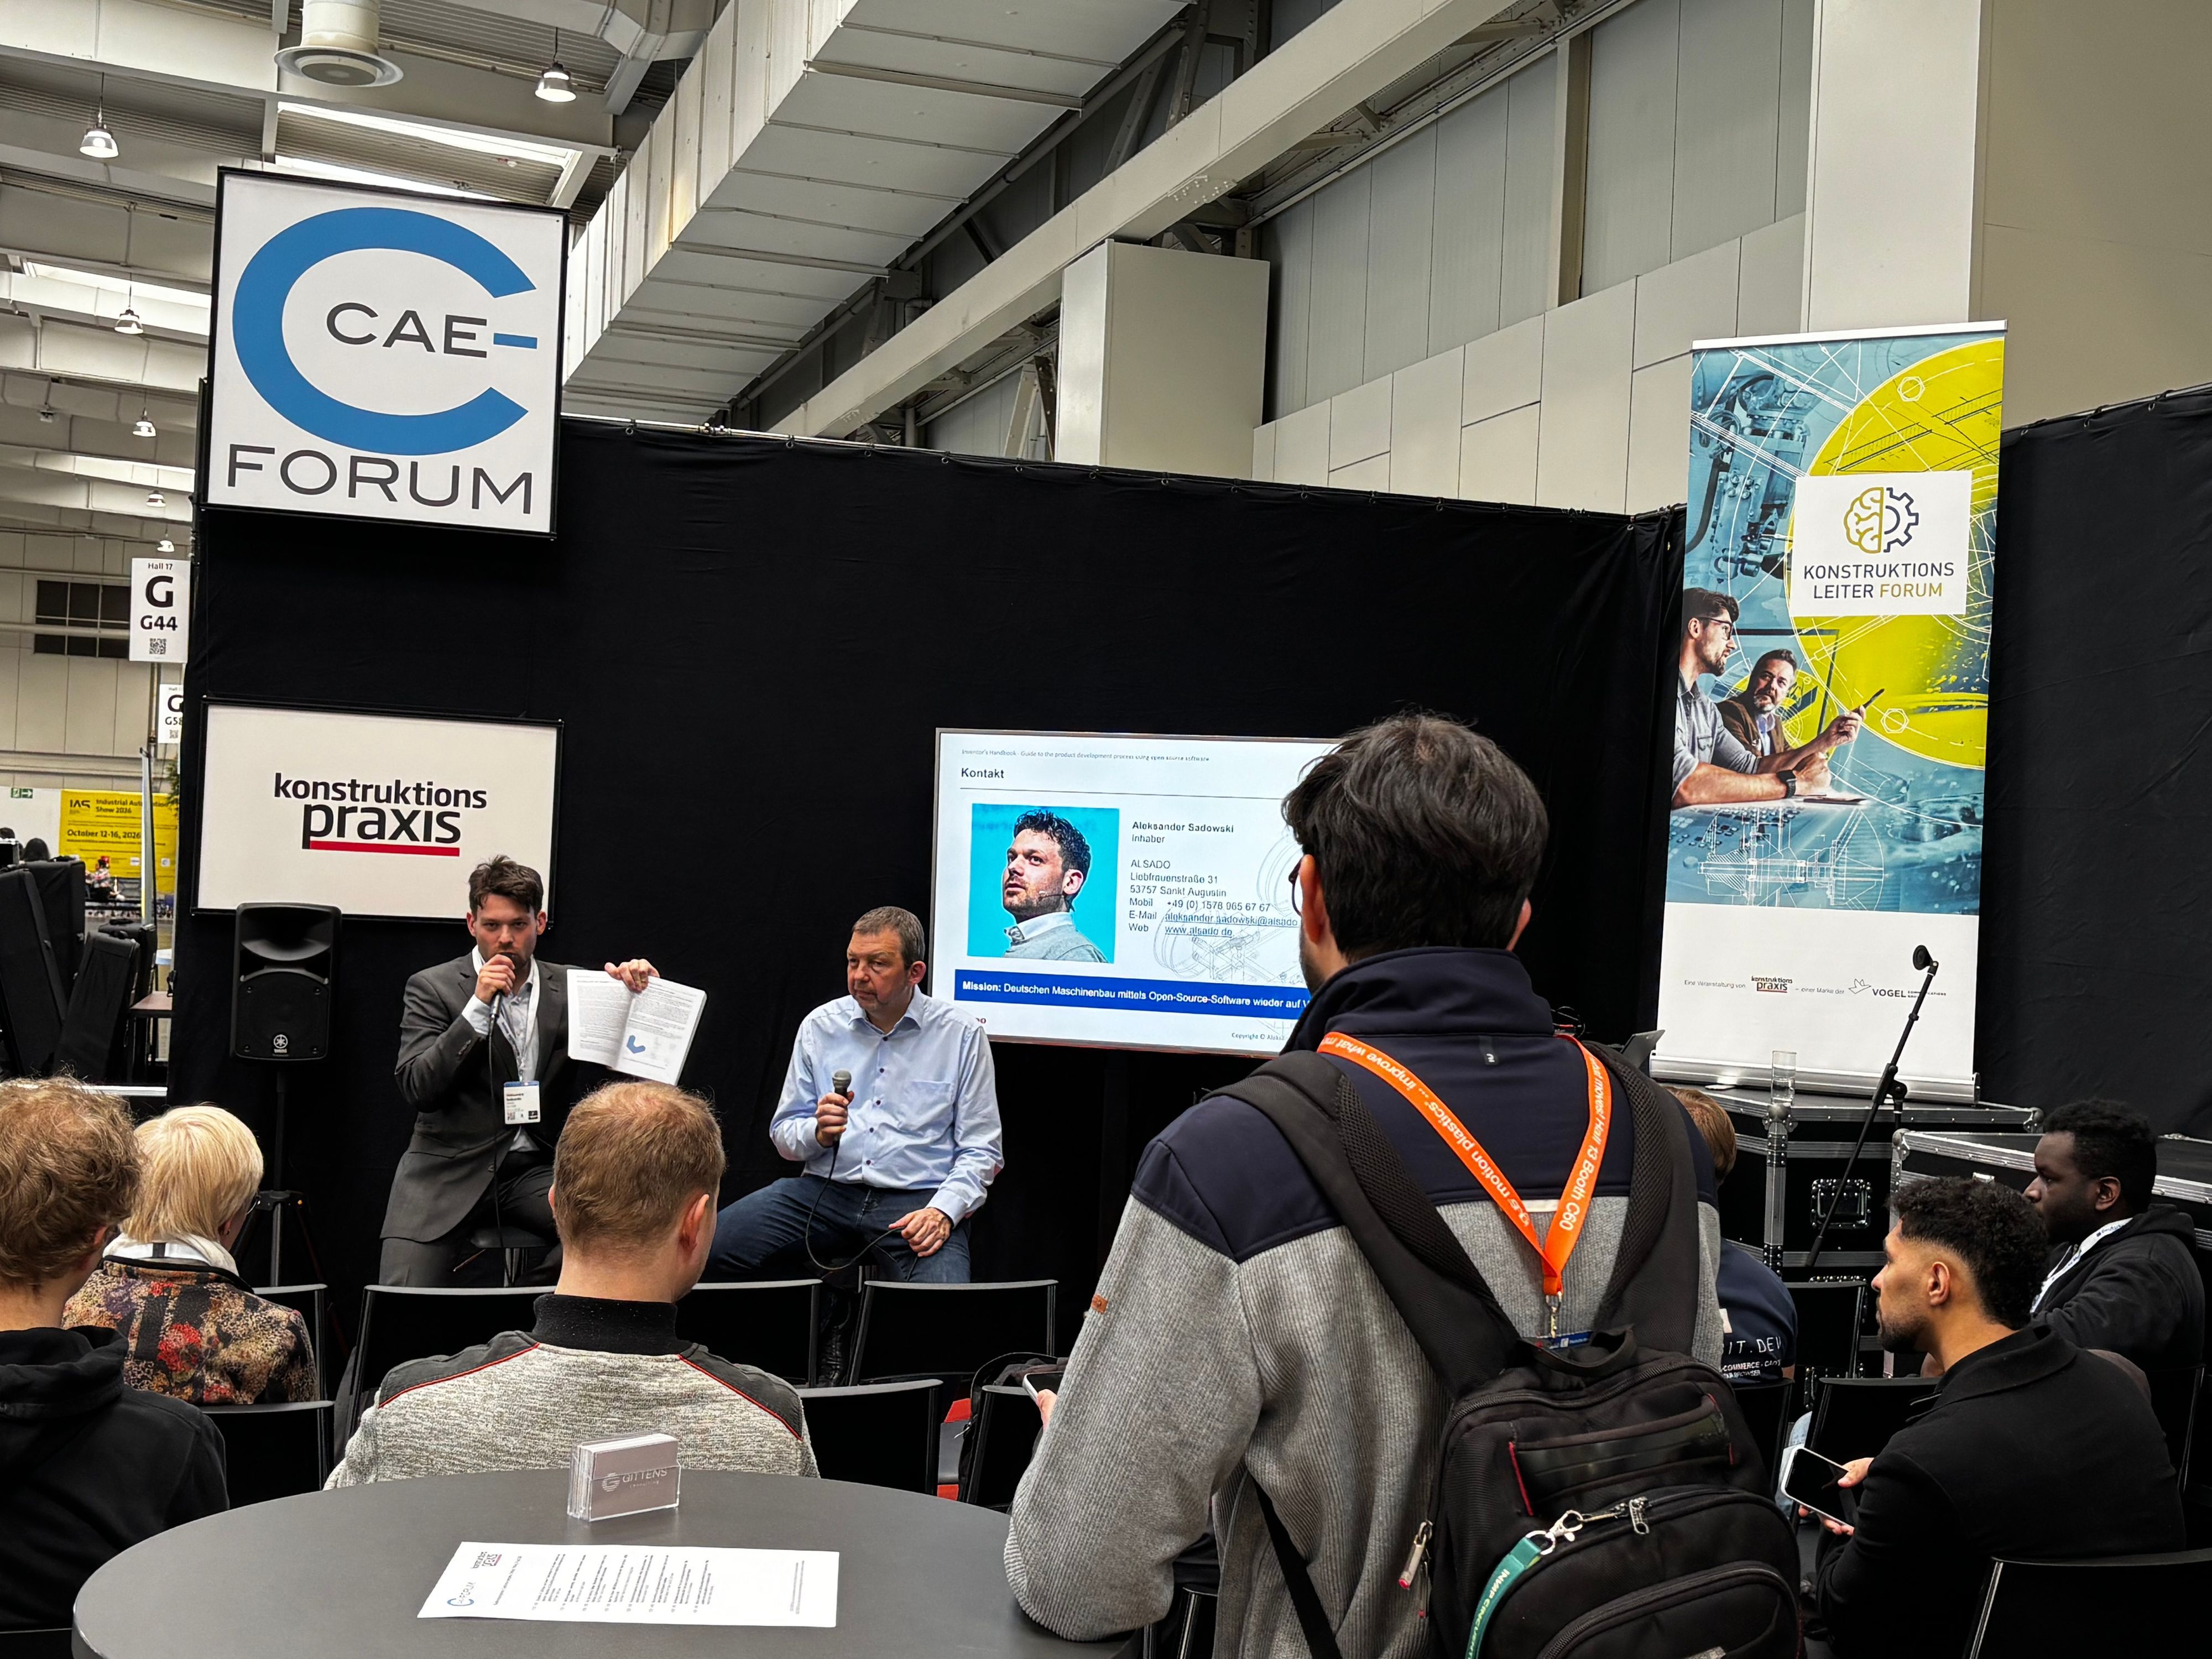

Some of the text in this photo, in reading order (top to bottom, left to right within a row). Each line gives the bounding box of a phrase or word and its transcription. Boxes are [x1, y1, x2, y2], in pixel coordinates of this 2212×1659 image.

[227, 444, 532, 515] FORUM
[1803, 561, 1955, 580] KONSTRUKTIONS
[145, 575, 174, 608] G
[1813, 582, 1943, 599] LEITER FORUM
[140, 615, 178, 631] G44
[961, 767, 1004, 779] Kontakt
[274, 772, 487, 809] konstruktions
[67, 829, 98, 837] October
[100, 830, 121, 839] 12-16,
[302, 803, 461, 849] praxis
[1188, 823, 1234, 833] Sadowski
[1131, 834, 1165, 843] Inhaber
[1130, 859, 1171, 869] ALSADO
[1207, 875, 1218, 884] 31
[1130, 884, 1227, 899] 53757 Sankt Augustin
[1129, 898, 1153, 907] Mobil
[1167, 899, 1184, 908] +49
[1186, 900, 1198, 911] (0)
[1245, 902, 1256, 911] 67
[1259, 903, 1271, 912] 67
[1129, 910, 1298, 927] E-Mail aleksander.sadowski@alsado
[1129, 922, 1149, 932] Web
[1751, 975, 1793, 984] konstruktions
[1756, 982, 1788, 992] praxis
[962, 980, 1001, 992] Mission:
[1003, 983, 1050, 995] Deutschen
[1052, 986, 1115, 998] Maschinenbau
[1117, 990, 1146, 1000] mittels
[1253, 997, 1284, 1008] wieder
[1286, 998, 1302, 1009] auf
[1872, 988, 1907, 998] VOGEL
[1335, 1037, 1366, 1056] what
[1366, 1052, 1417, 1091] improve
[1594, 1077, 1606, 1120] moves!
[1592, 1117, 1606, 1145] Hall
[1587, 1145, 1598, 1161] 13
[1471, 1151, 1511, 1198] motion
[1571, 1159, 1595, 1201] Booth
[1559, 1202, 1580, 1231] C60
